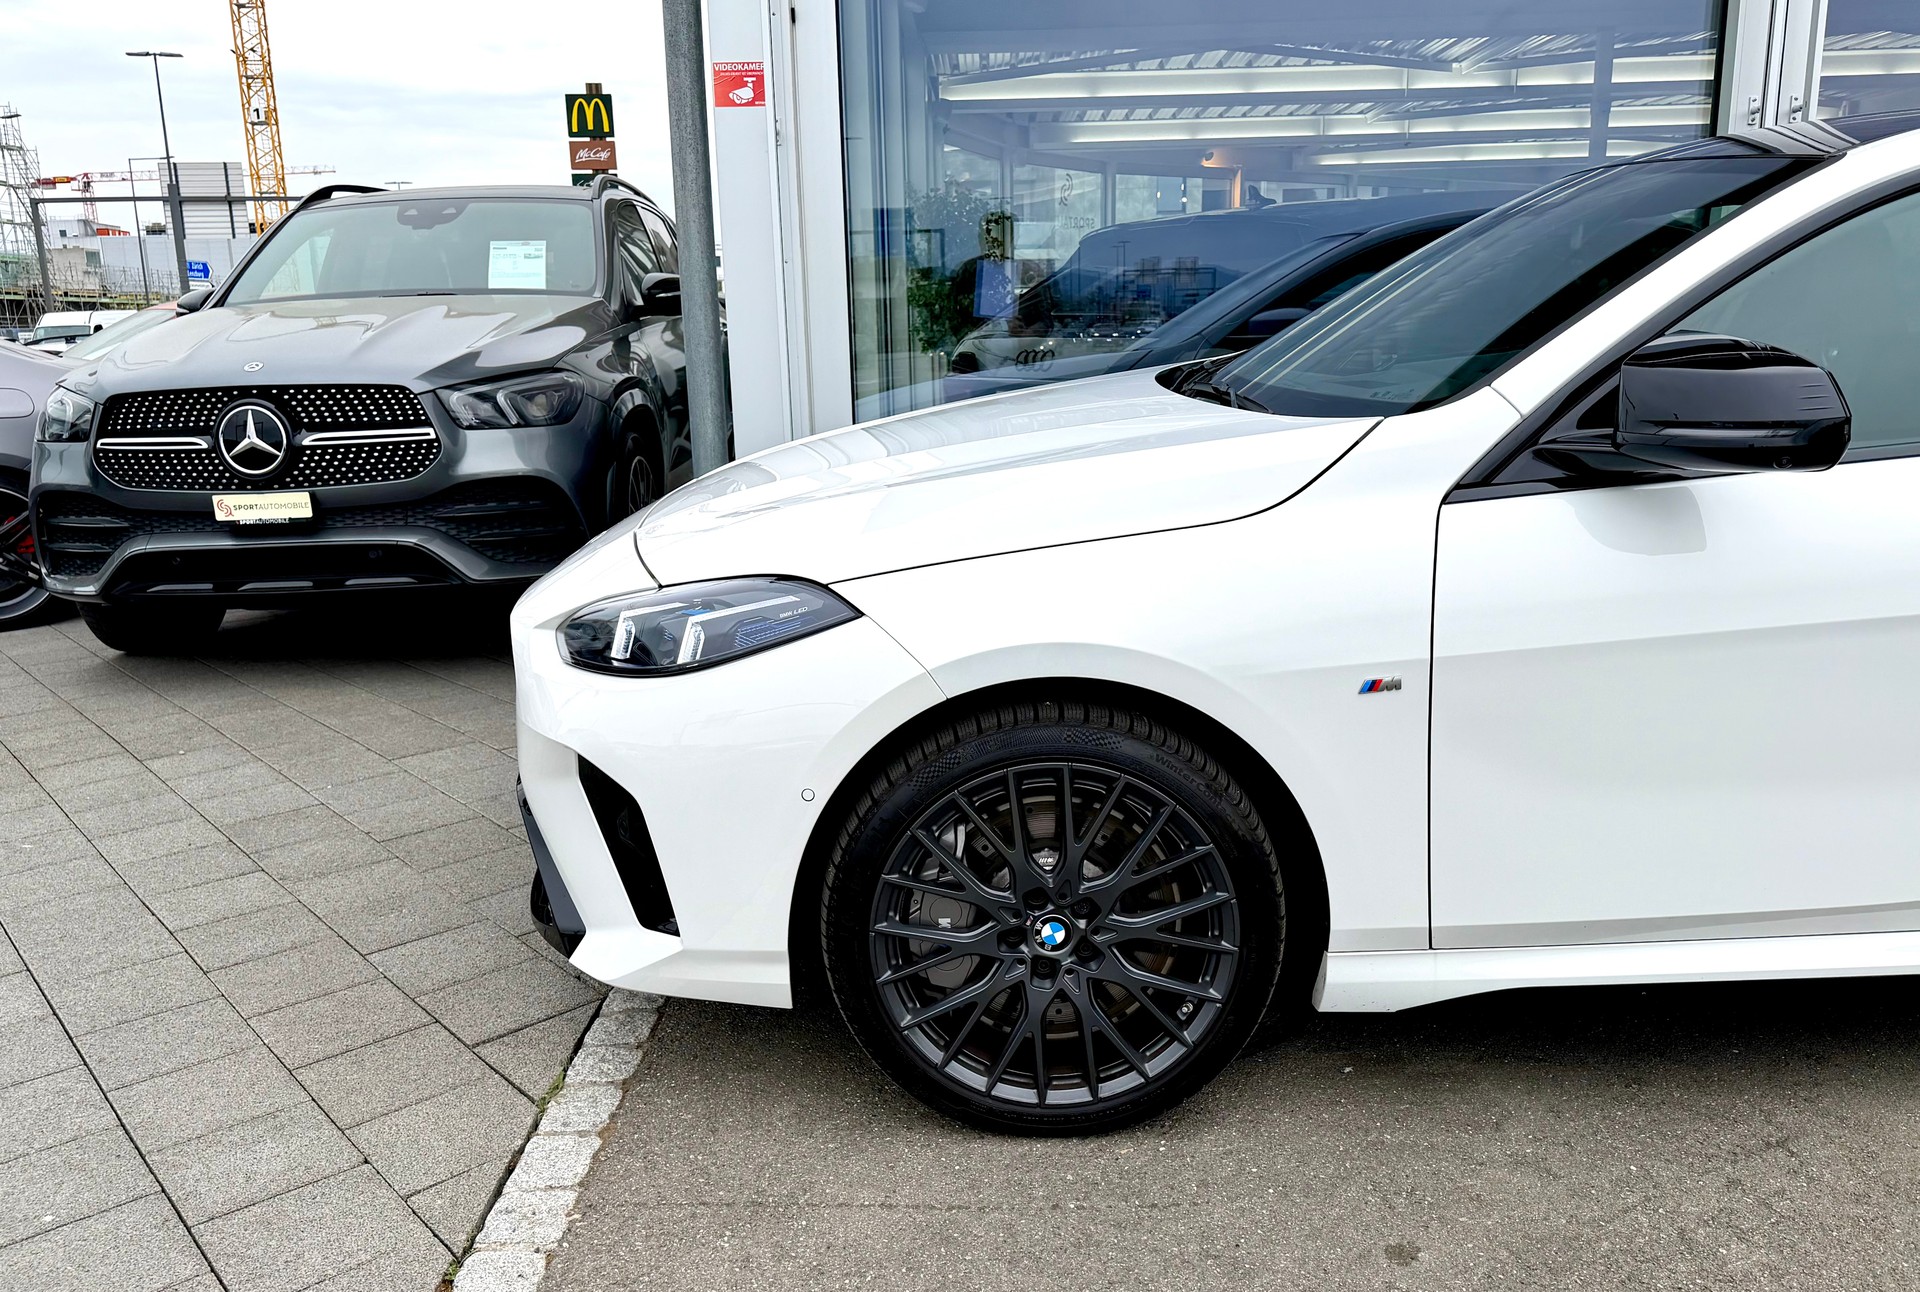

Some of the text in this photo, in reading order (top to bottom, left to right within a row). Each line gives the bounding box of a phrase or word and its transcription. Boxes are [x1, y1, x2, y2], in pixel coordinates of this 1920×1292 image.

[253, 108, 260, 120] 1
[233, 502, 310, 511] SPORTAUTOMOBILE
[793, 606, 808, 615] LED
